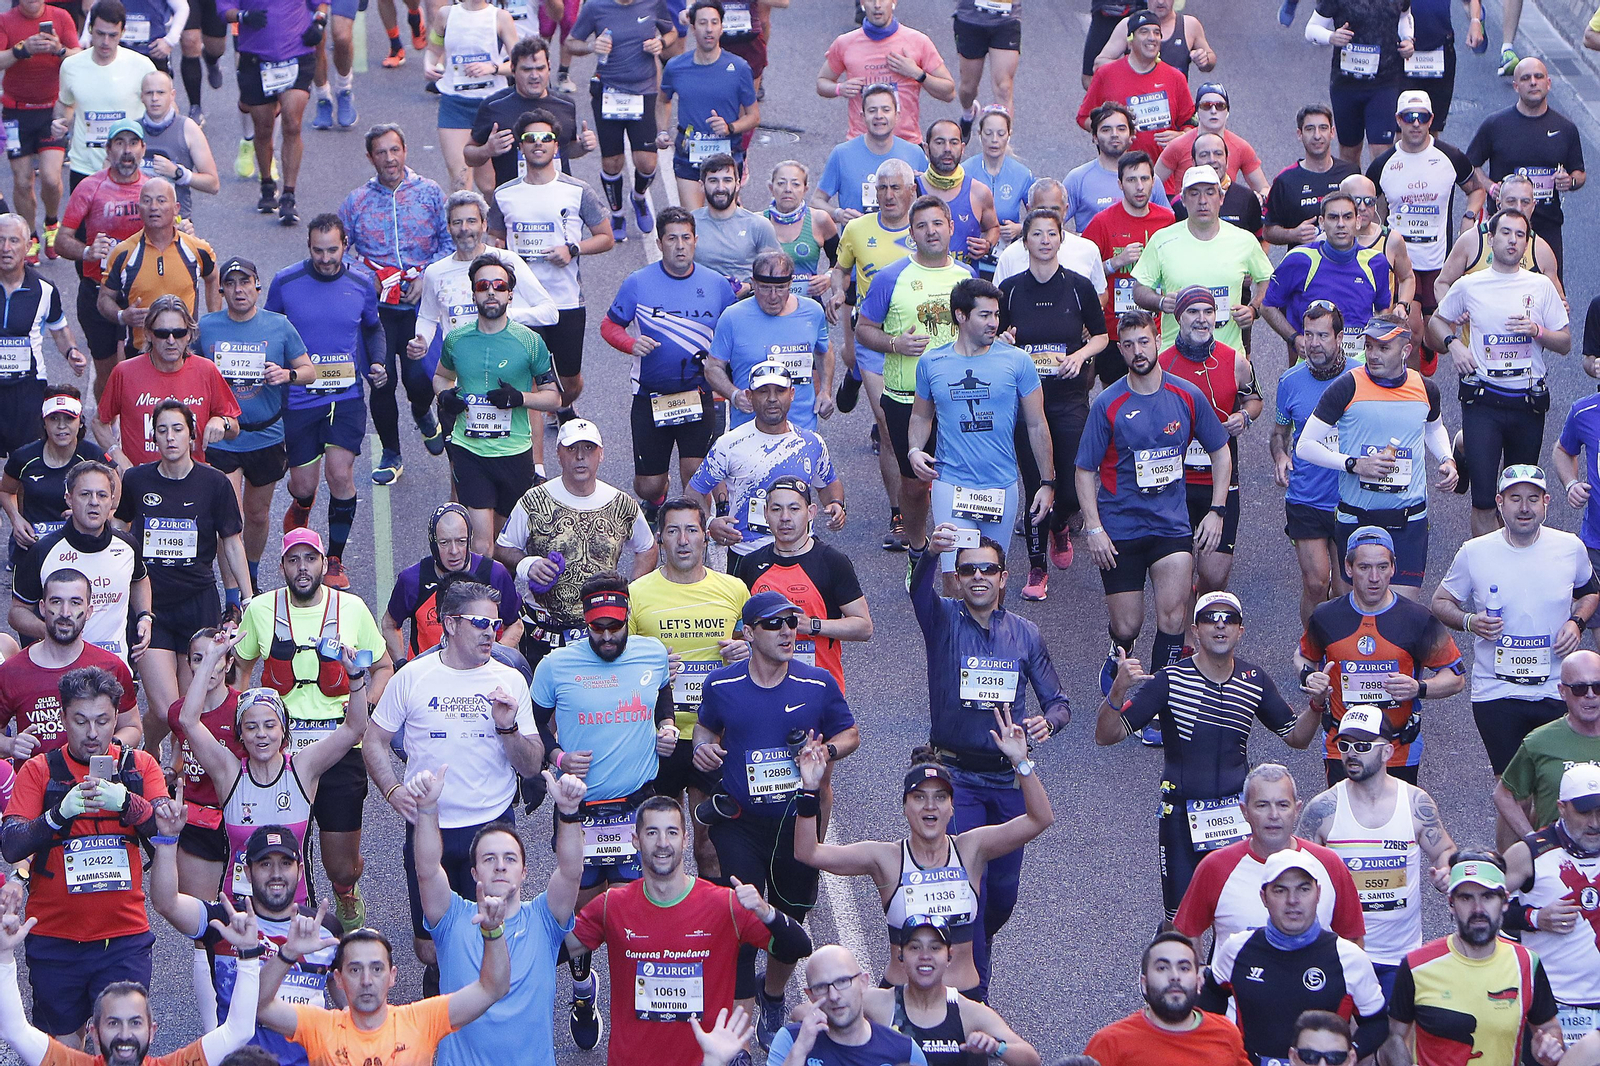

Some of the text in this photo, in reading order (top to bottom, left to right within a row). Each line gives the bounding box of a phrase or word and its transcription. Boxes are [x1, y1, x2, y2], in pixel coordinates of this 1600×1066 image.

[464, 54, 487, 62] ZURICH
[1350, 57, 1370, 65] 10490
[1140, 93, 1164, 103] ZURICH
[1140, 105, 1160, 114] 11809
[1390, 161, 1403, 171] edp
[1528, 168, 1552, 176] ZURICH
[1408, 180, 1428, 190] edp
[1500, 335, 1527, 343] ZURICH
[232, 344, 260, 352] ZURICH
[782, 345, 809, 353] ZURICH
[1033, 343, 1061, 352] ZURICH
[321, 354, 348, 363] ZURICH
[1500, 351, 1518, 359] 7537
[321, 370, 341, 378] 3525
[236, 385, 254, 393] 2017
[136, 392, 161, 406] Mer
[184, 395, 204, 406] eins
[476, 412, 497, 420] 8788
[663, 407, 692, 417] CENCERRA
[729, 433, 756, 449] aero
[1324, 435, 1338, 443] 117
[1151, 448, 1179, 459] ZURICH
[1151, 465, 1174, 475] 10253
[1155, 476, 1170, 484] XUFO
[969, 493, 993, 503] 10663
[955, 502, 1002, 513] JAVI FERNANDEZ
[161, 520, 191, 529] ZURICH
[158, 538, 184, 546] 11498
[59, 552, 78, 564] edp
[91, 591, 117, 599] aratón
[659, 618, 725, 630] LET'S MOVE
[705, 630, 725, 638] WORLD
[1513, 638, 1545, 646] ZURICH
[981, 659, 1014, 669] ZURICH
[1510, 656, 1538, 664] 10095
[1359, 663, 1392, 671] ZURICH
[976, 676, 1004, 686] 12318
[1360, 681, 1383, 690] 7898
[978, 691, 999, 699] 67133
[1360, 691, 1383, 700] TOÑITO
[442, 696, 485, 705] CARRERA
[440, 704, 487, 712] EMPRESAS
[32, 720, 67, 735] ROS
[298, 720, 330, 729] ZURICH
[765, 750, 791, 760] ZURIC
[763, 767, 792, 778] 12896
[756, 784, 773, 793] LOVE
[1206, 797, 1239, 809] ZURICH
[596, 815, 631, 825] ZURICH
[1206, 816, 1235, 827] 10853
[597, 834, 621, 842] 6395
[1205, 828, 1238, 839] BENTAYEB
[84, 838, 120, 848] ZURICH
[1383, 839, 1408, 850] 226ERS
[596, 846, 622, 854] ALVARO
[83, 856, 113, 867] 12422
[1364, 859, 1400, 868] ZURICH
[76, 871, 122, 882] KAMIASSAVA
[925, 870, 960, 882] ZURICH
[1365, 879, 1390, 888] 5597
[924, 891, 956, 902] 11336
[1367, 892, 1395, 900] SANTOS
[625, 949, 710, 960] Carreras Populares
[657, 966, 695, 975] ZURICH
[284, 974, 320, 987] ZURICH
[654, 987, 687, 997] 10619
[650, 1001, 688, 1010] MONTORO
[1560, 1016, 1592, 1026] 11882
